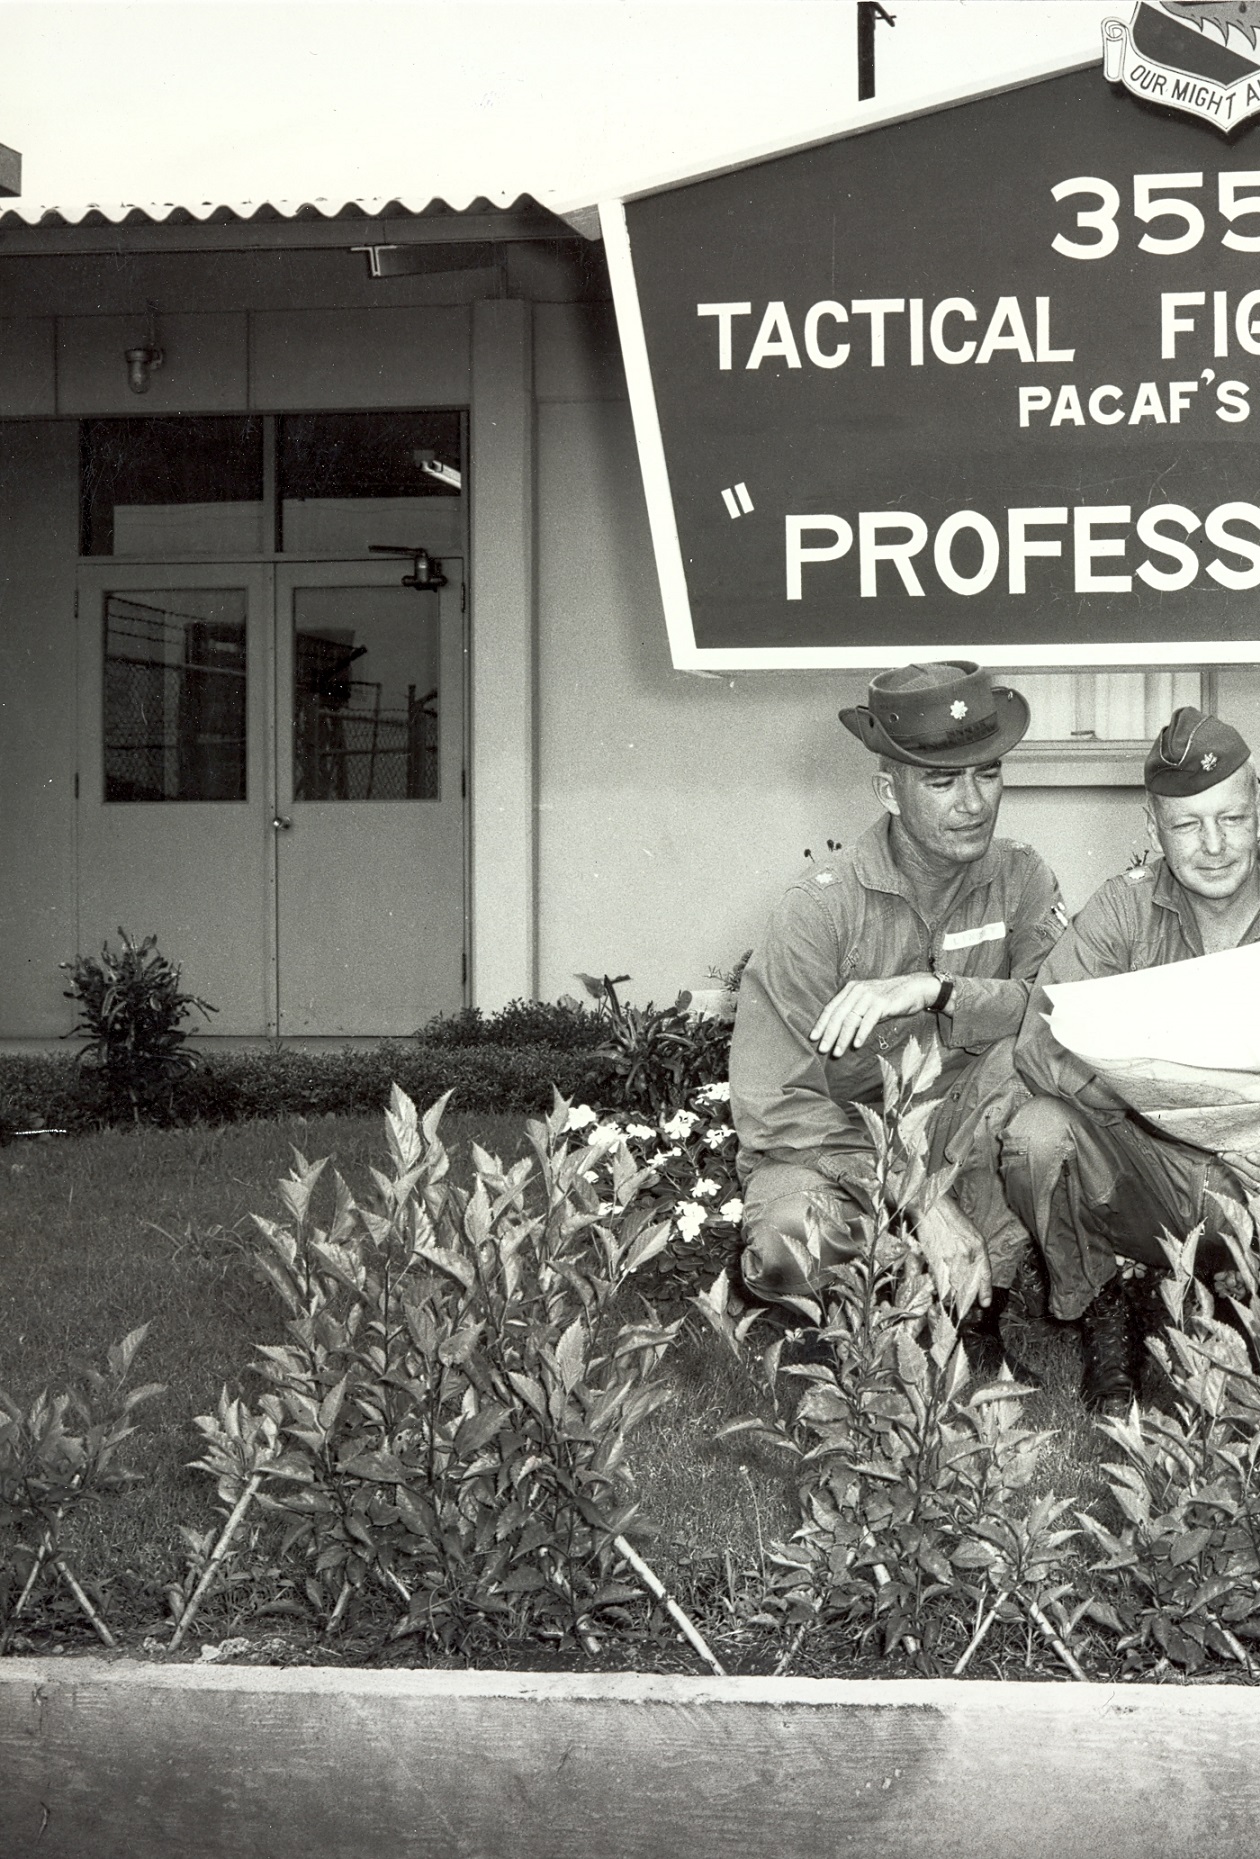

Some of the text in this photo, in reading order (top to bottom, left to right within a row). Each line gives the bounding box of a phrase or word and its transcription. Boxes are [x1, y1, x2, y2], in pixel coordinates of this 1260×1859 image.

[1130, 64, 1167, 96] OUR
[1171, 78, 1237, 120] MIGHT
[697, 296, 1075, 370] TACTICAL
[1019, 368, 1250, 427] PACAF'S
